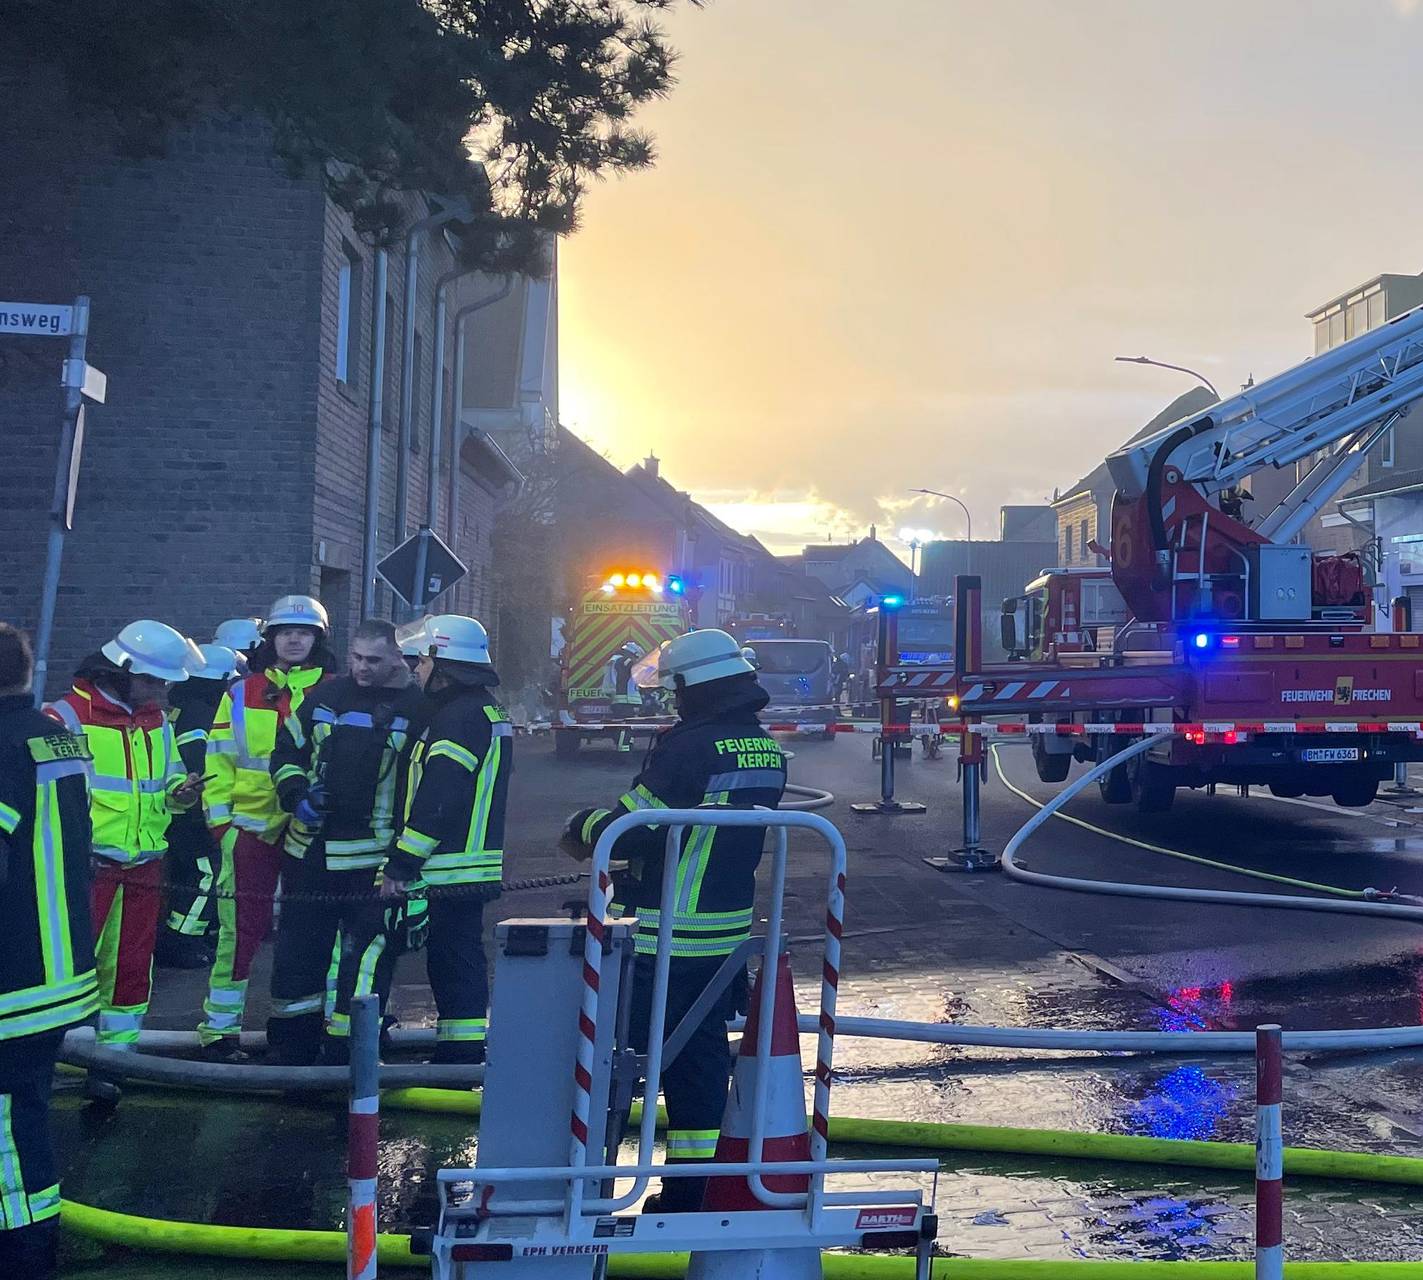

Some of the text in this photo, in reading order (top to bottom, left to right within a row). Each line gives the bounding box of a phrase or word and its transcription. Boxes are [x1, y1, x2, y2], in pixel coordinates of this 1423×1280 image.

[585, 602, 677, 613] EINSATZLEITUNG
[1281, 689, 1391, 702] FEUERWEHR FRECHEN
[737, 752, 781, 768] KERPEN
[1337, 749, 1357, 759] 6361
[523, 1244, 608, 1257] EPH VERKEHR
